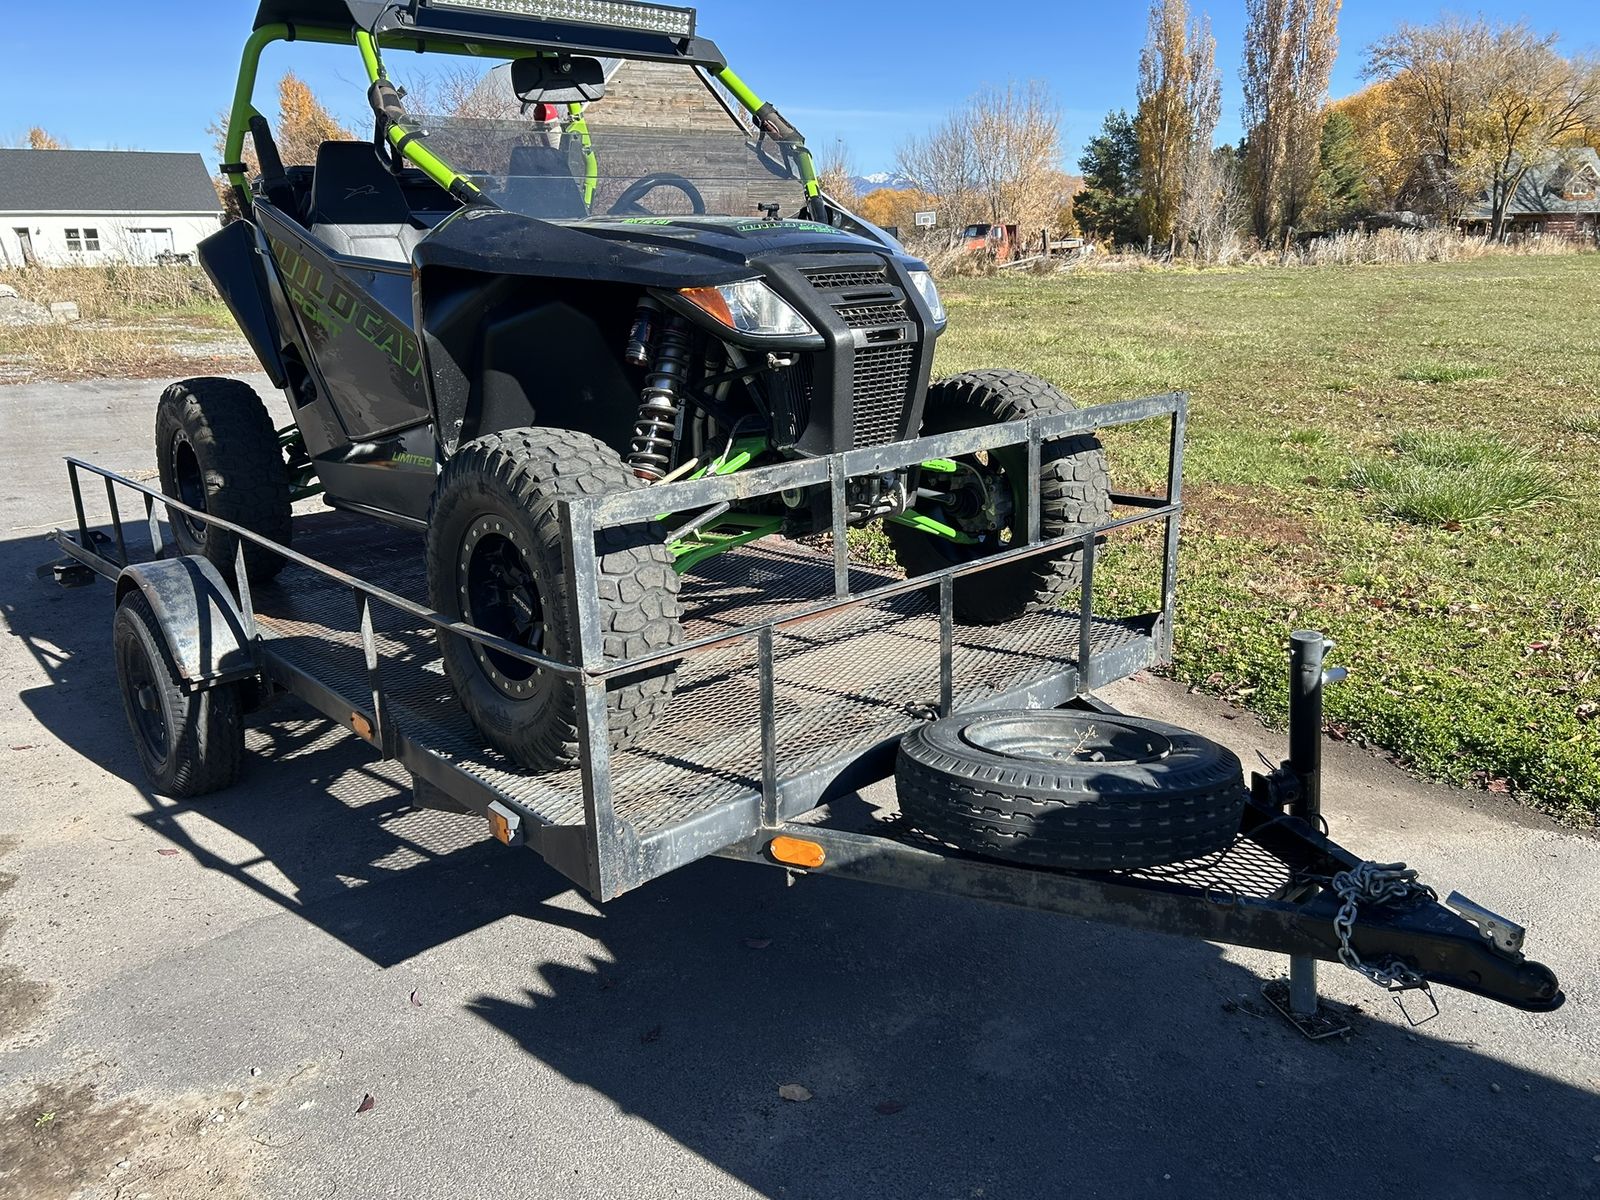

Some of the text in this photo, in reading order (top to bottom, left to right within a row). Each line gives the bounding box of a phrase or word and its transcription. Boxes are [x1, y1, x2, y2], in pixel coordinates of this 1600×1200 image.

[271, 237, 423, 377] WILDCAT
[287, 286, 343, 338] PORT
[391, 451, 433, 468] LIMITED
